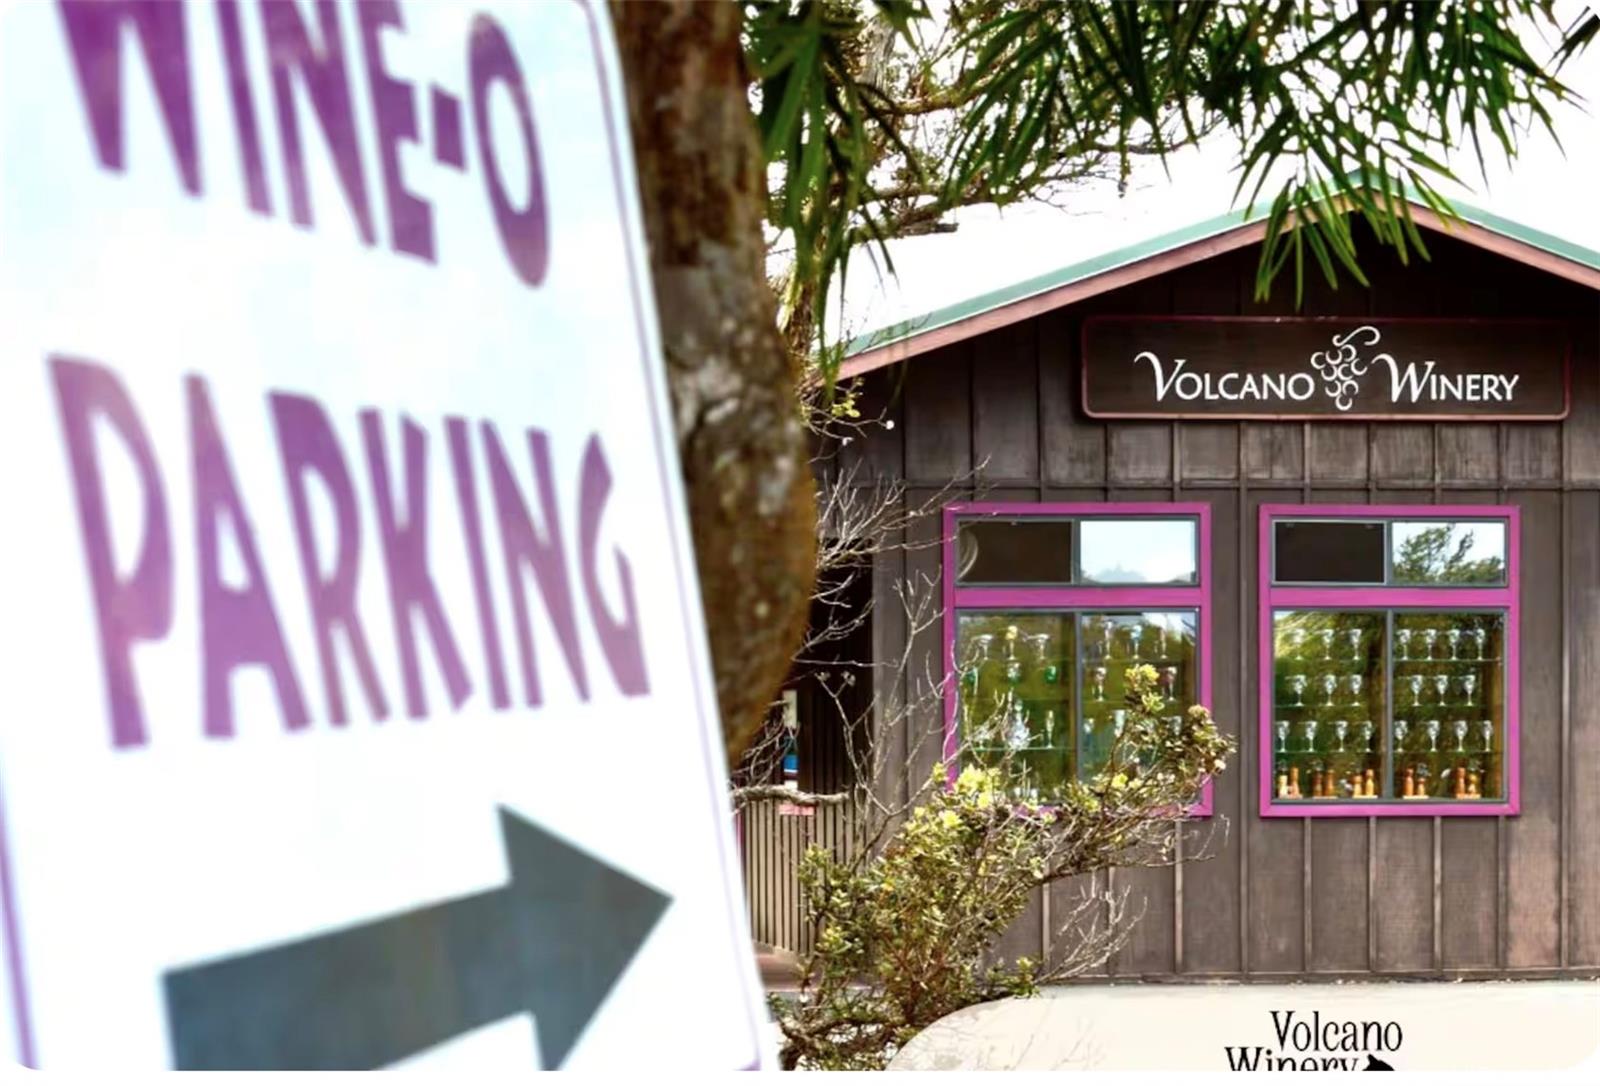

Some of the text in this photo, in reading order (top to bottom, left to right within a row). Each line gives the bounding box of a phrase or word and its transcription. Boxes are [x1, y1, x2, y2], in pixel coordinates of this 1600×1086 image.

[1134, 351, 1520, 403] VOLCANO WINERY
[47, 354, 651, 748] PARKING
[1269, 1010, 1403, 1052] Volcano
